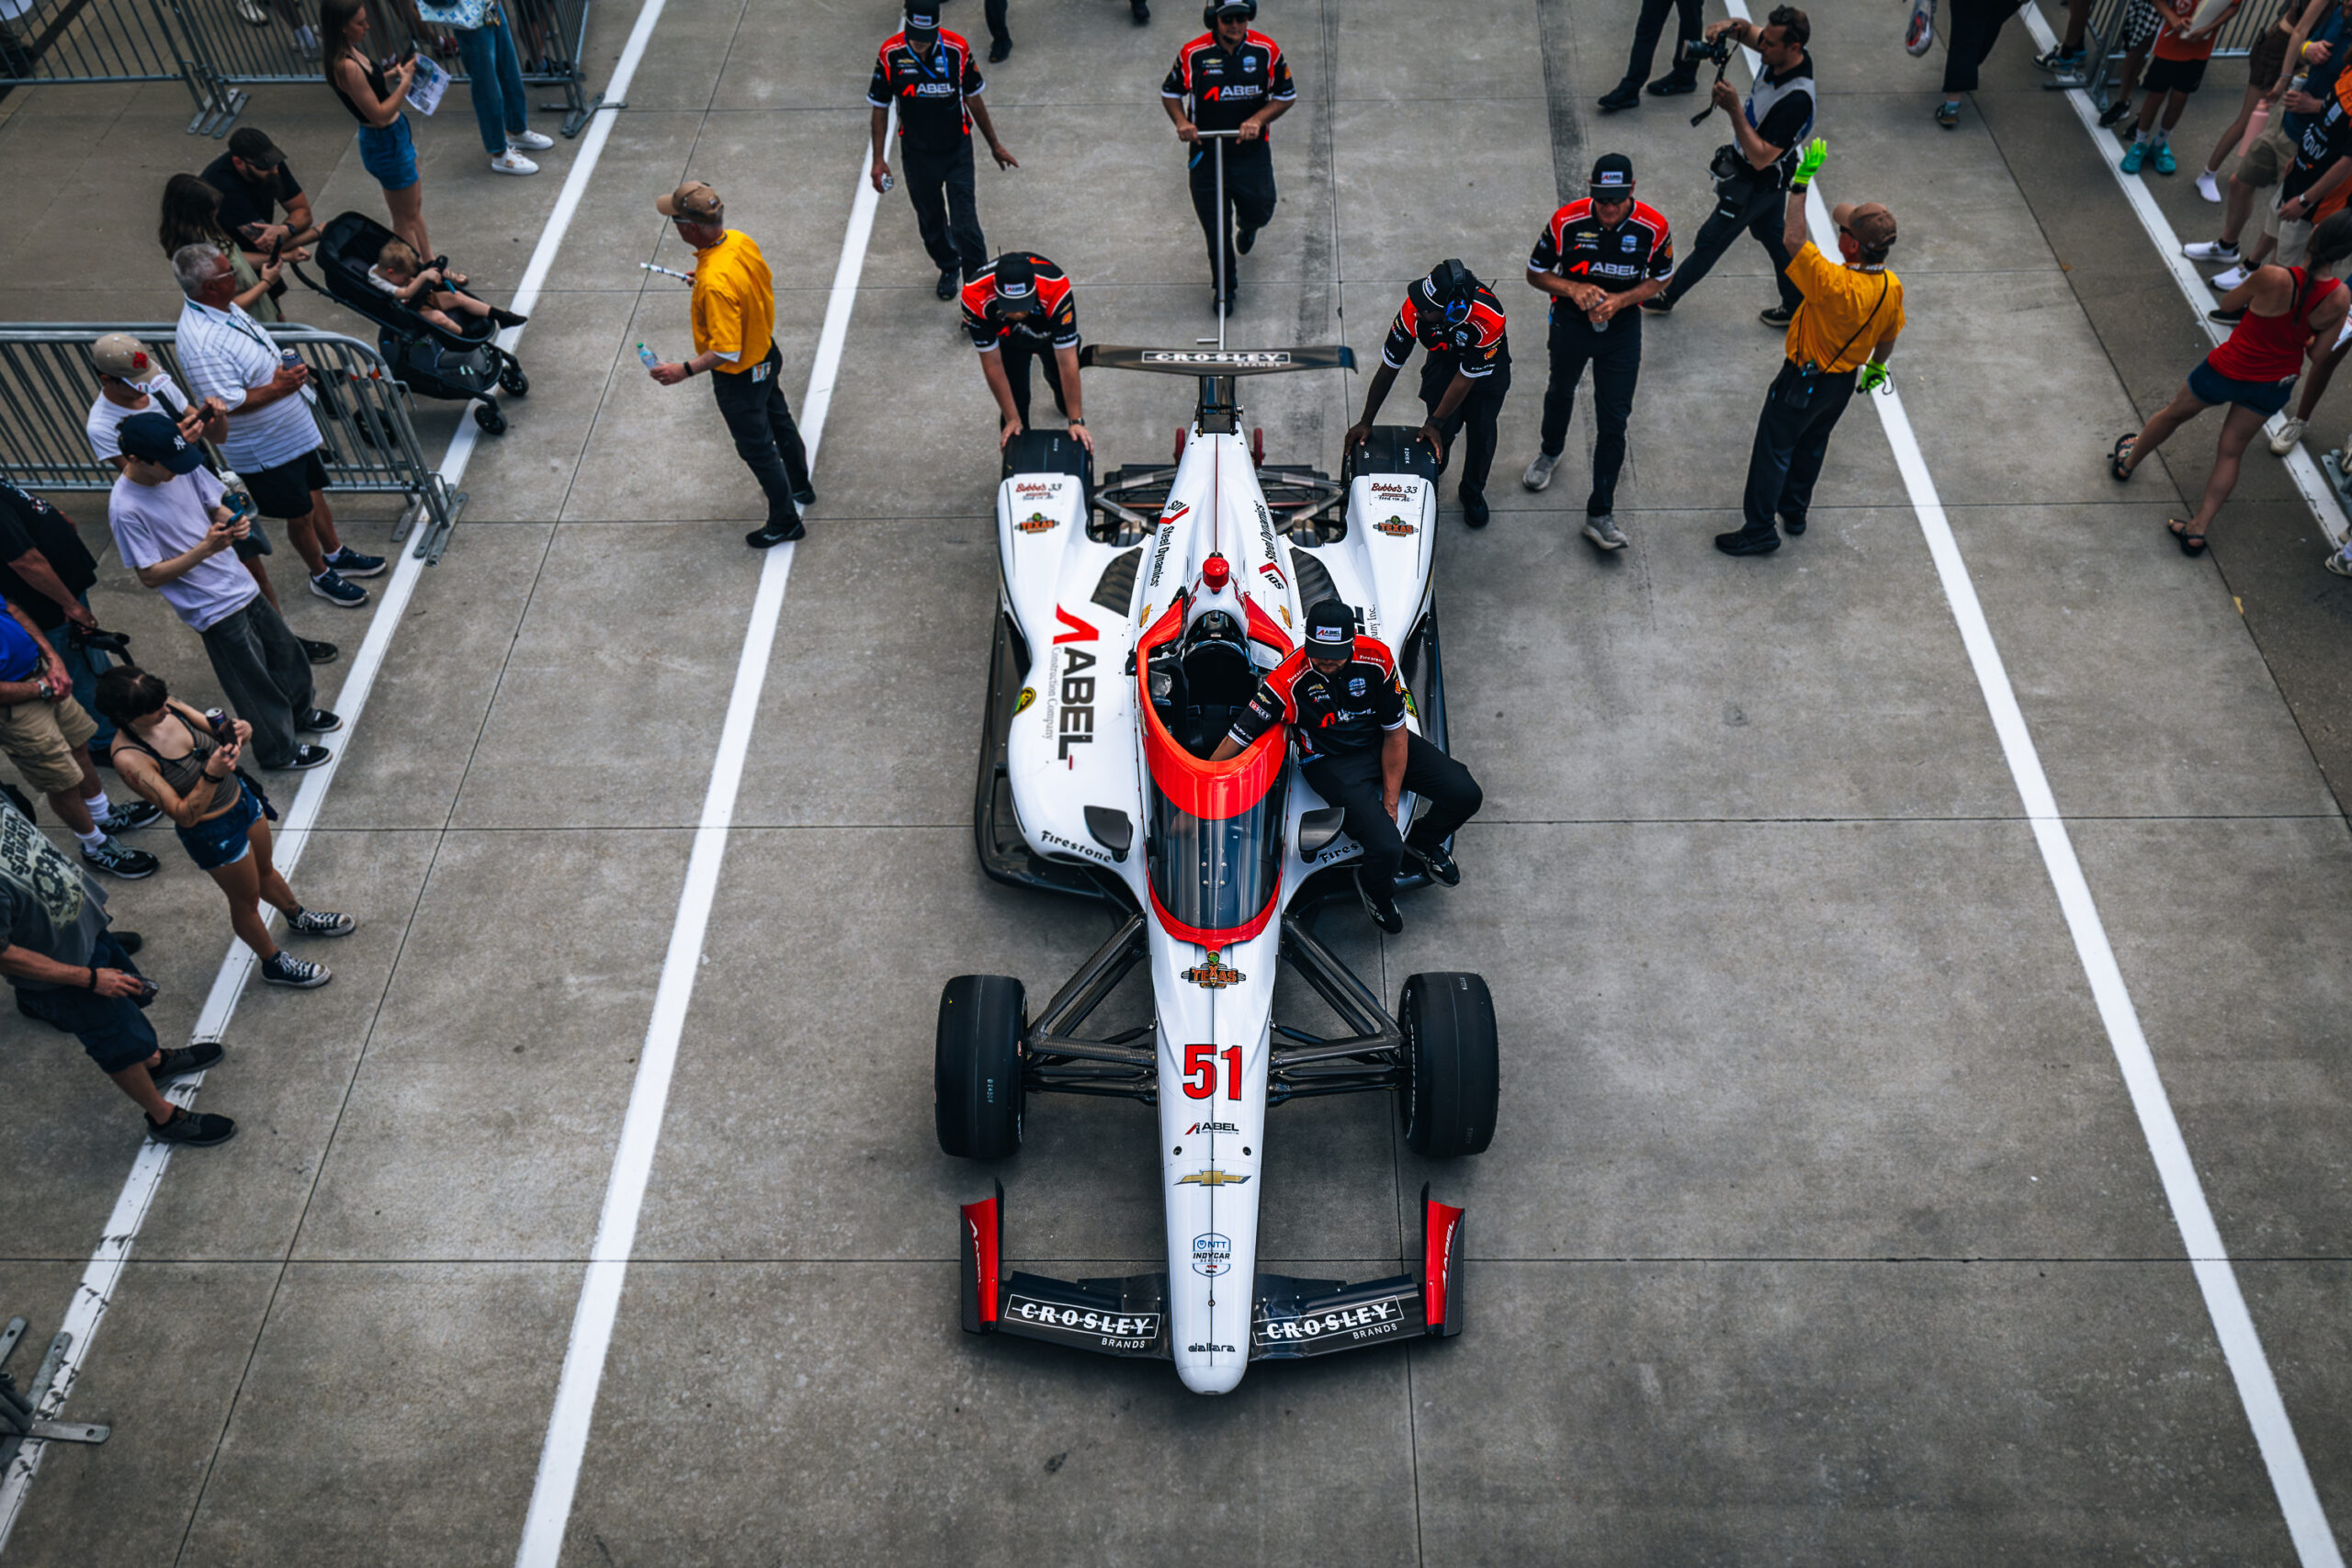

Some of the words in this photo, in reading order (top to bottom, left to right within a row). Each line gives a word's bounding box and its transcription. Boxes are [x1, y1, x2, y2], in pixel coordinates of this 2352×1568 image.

[916, 83, 955, 94] ABEL
[1220, 85, 1262, 96] ABEL
[1589, 262, 1639, 276] ABEL
[1155, 353, 1280, 362] CROSLEY
[1048, 482, 1062, 491] 33
[1371, 482, 1402, 492] Bubba's
[1404, 485, 1418, 494] 33
[1168, 500, 1186, 512] SDI
[1159, 525, 1174, 547] Steel
[1379, 523, 1413, 534] TEXAS
[1262, 538, 1278, 563] Steel
[1264, 573, 1284, 591] SDI
[1367, 604, 1377, 621] Inc.
[1359, 654, 1385, 663] Firestone
[1047, 647, 1063, 697] Construction
[1287, 664, 1309, 684] Firestone
[1058, 646, 1097, 760] ABEL
[1042, 696, 1058, 740] Company
[1041, 830, 1113, 863] Firestone
[1318, 842, 1360, 864] Fires
[1192, 965, 1238, 983] TEXAS
[1182, 1044, 1243, 1101] 51
[1202, 1122, 1239, 1132] ABEL
[1021, 1303, 1150, 1336] CROSLEY
[1266, 1302, 1390, 1340] CROSLEY
[1351, 1323, 1398, 1340] BRANDS
[1102, 1337, 1146, 1348] BRANDS
[1188, 1342, 1236, 1352] dallara
